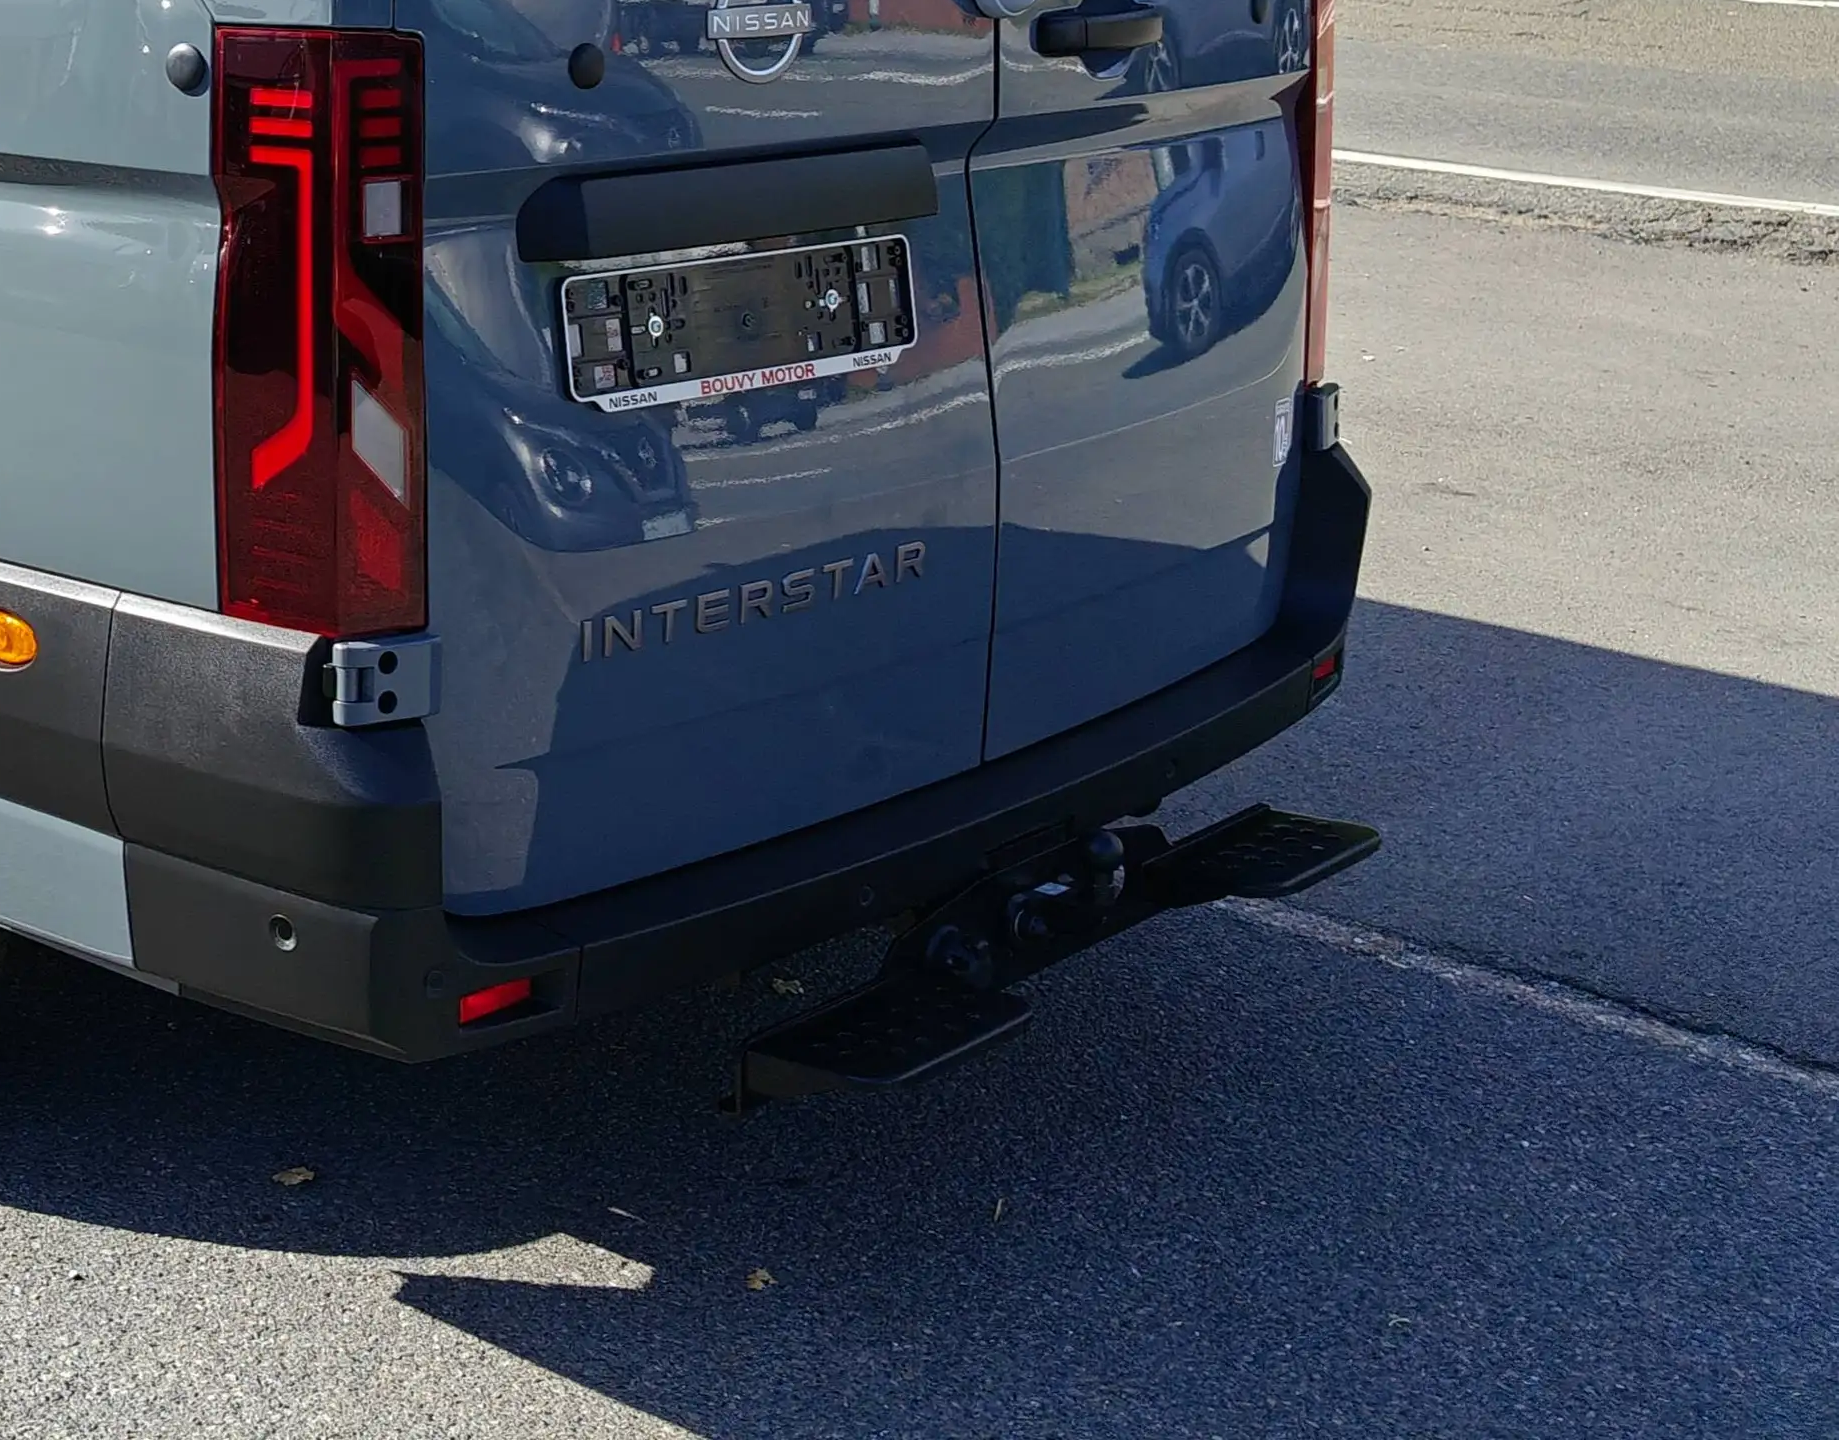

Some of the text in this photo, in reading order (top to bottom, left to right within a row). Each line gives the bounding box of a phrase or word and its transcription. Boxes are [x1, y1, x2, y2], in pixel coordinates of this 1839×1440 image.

[712, 9, 810, 34] NISSAN
[608, 351, 892, 409] NISSAN BOUVY MOTOR NISSAN
[580, 539, 927, 663] INTERSTAR
